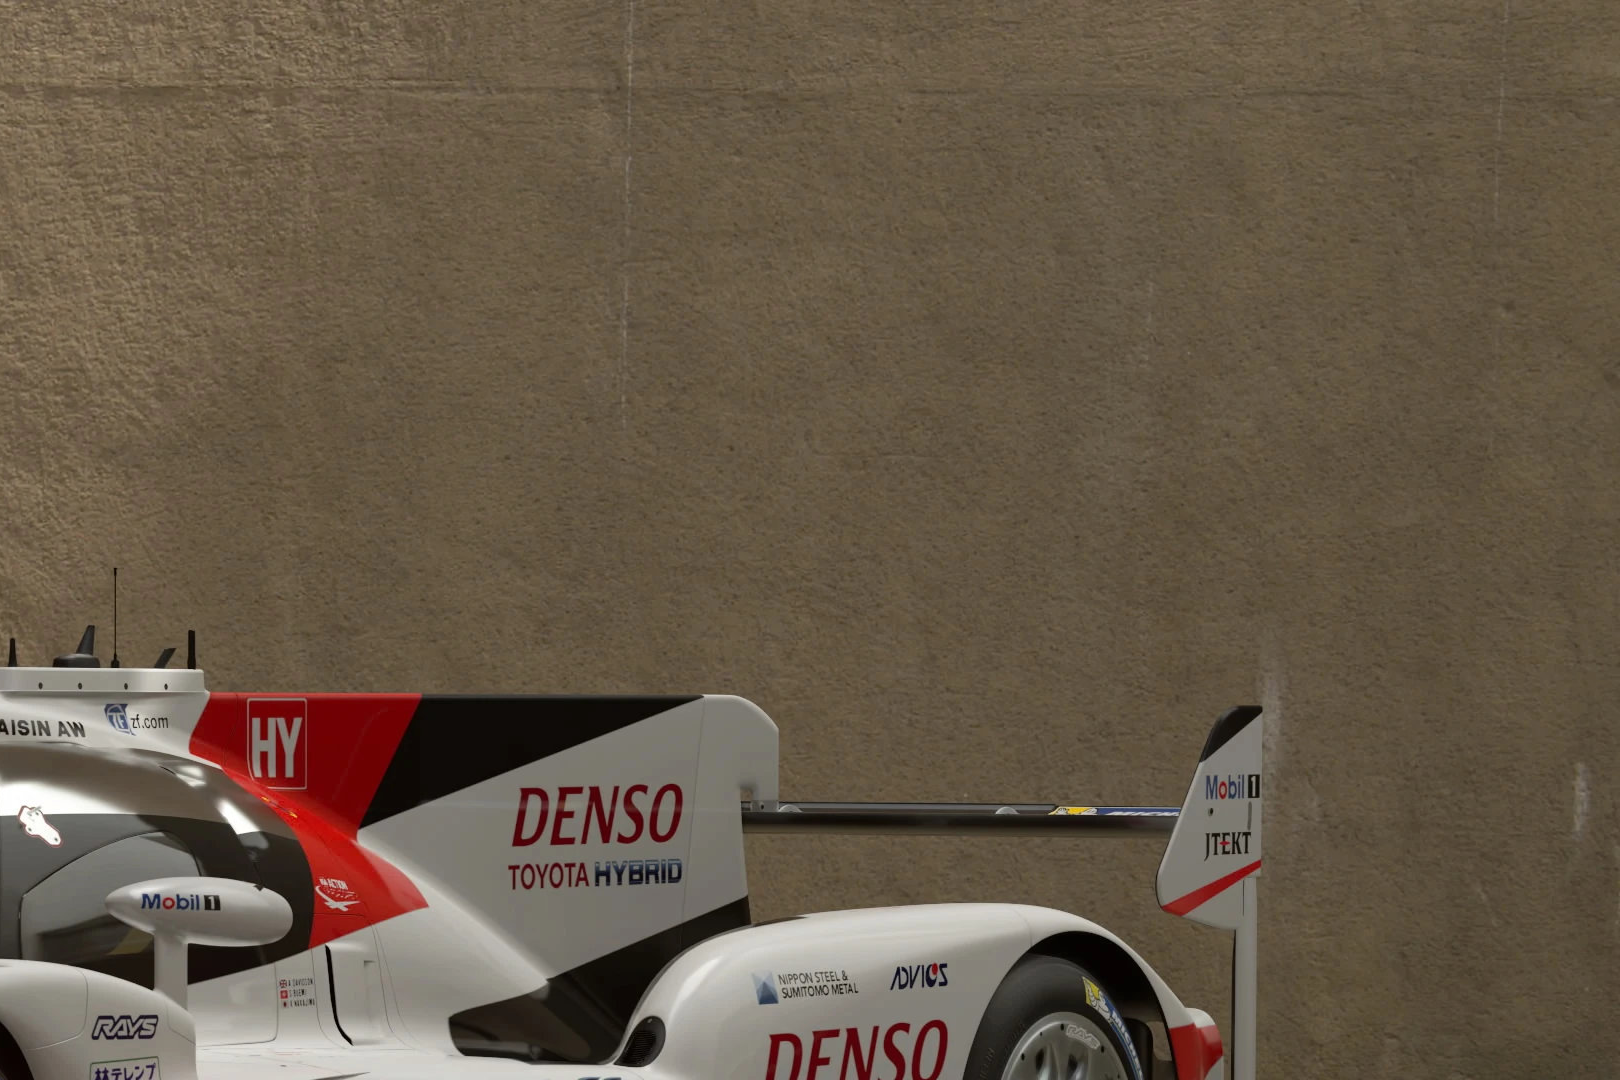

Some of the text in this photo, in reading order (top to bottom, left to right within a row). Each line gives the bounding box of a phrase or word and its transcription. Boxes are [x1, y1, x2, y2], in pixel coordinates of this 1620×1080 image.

[58, 720, 87, 738] AW
[130, 713, 169, 729] zf.com
[251, 717, 303, 778] HY
[1205, 775, 1258, 800] Mobil 1
[512, 783, 684, 847] DENSO
[1204, 832, 1251, 861] JTEKT
[508, 858, 683, 890] TOYOTA HYBRID
[141, 893, 219, 911] Mobil 1
[778, 970, 849, 986] NIPPON STEEL &
[782, 982, 859, 999] SUMITOMO METAL
[91, 1015, 159, 1040] RAYS
